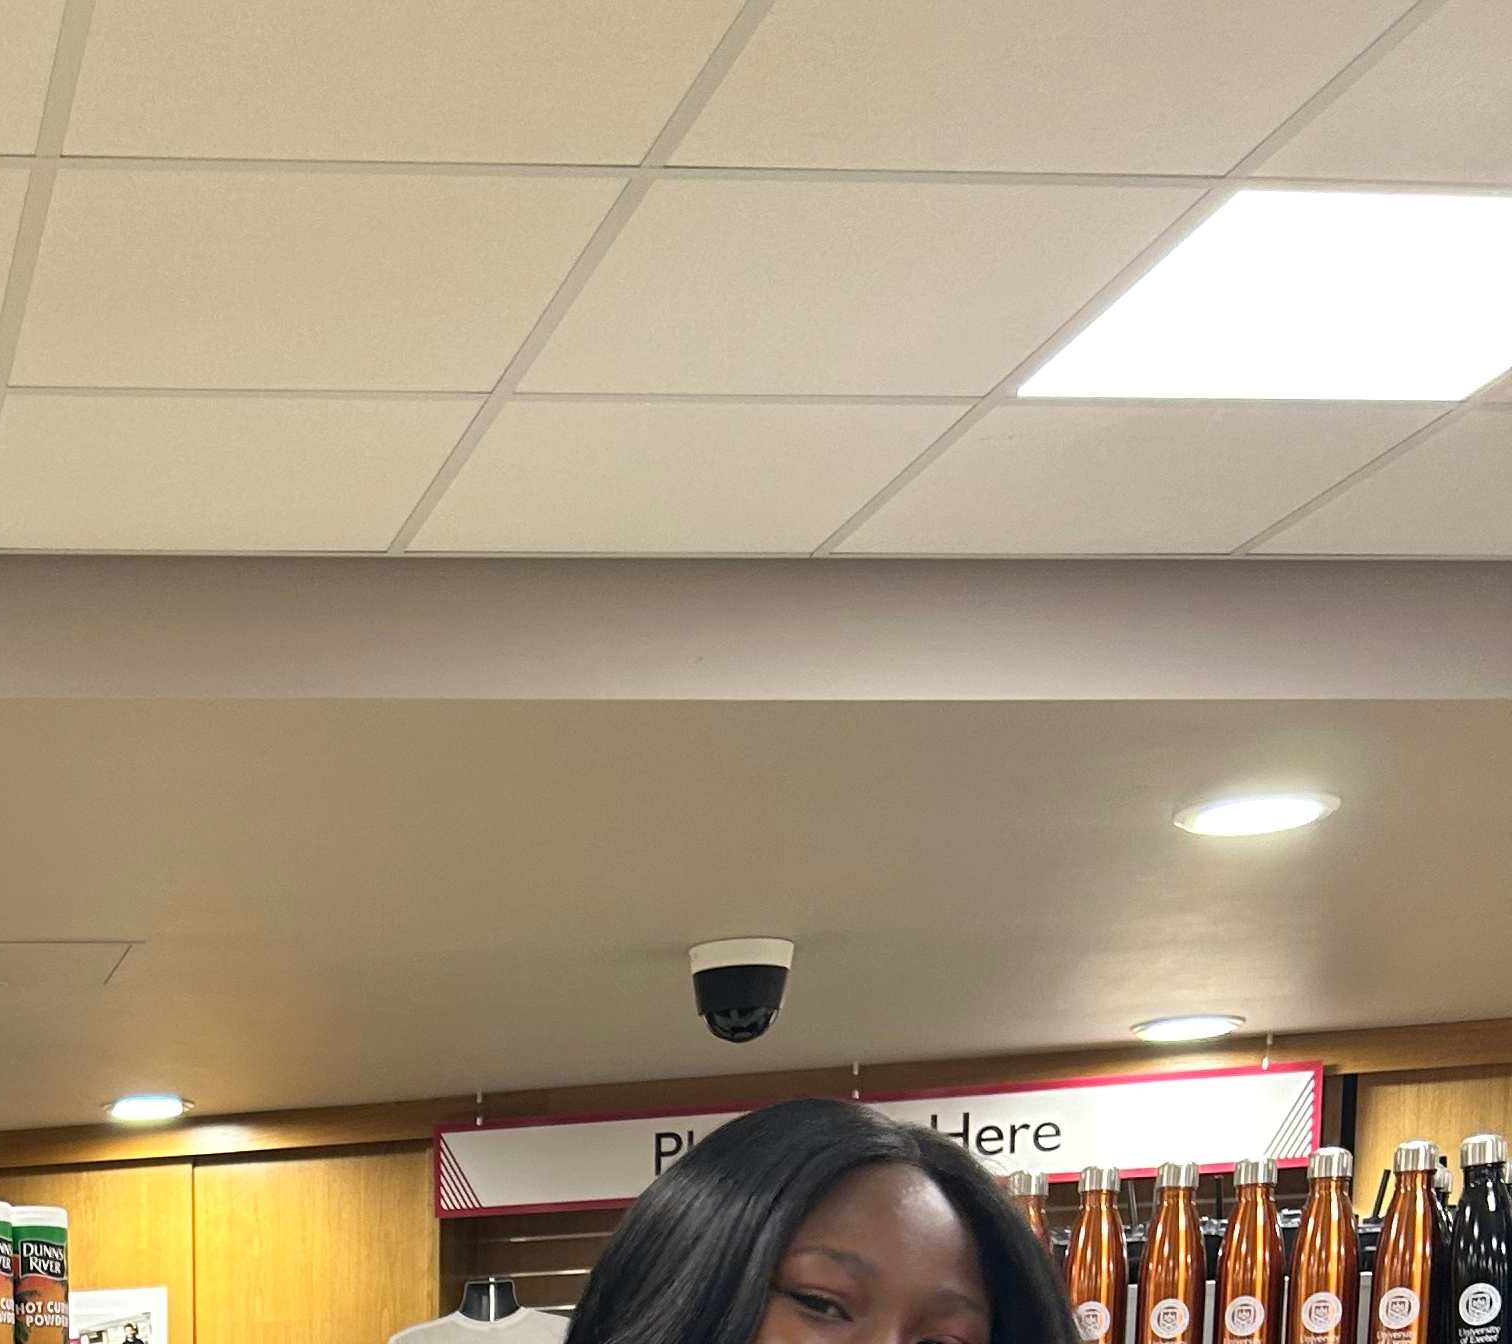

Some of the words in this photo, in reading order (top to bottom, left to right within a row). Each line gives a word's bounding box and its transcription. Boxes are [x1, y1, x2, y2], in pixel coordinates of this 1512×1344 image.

[930, 1112, 1061, 1154] Here
[1458, 1325, 1500, 1337] University
[1471, 1333, 1499, 1344] Exeter
